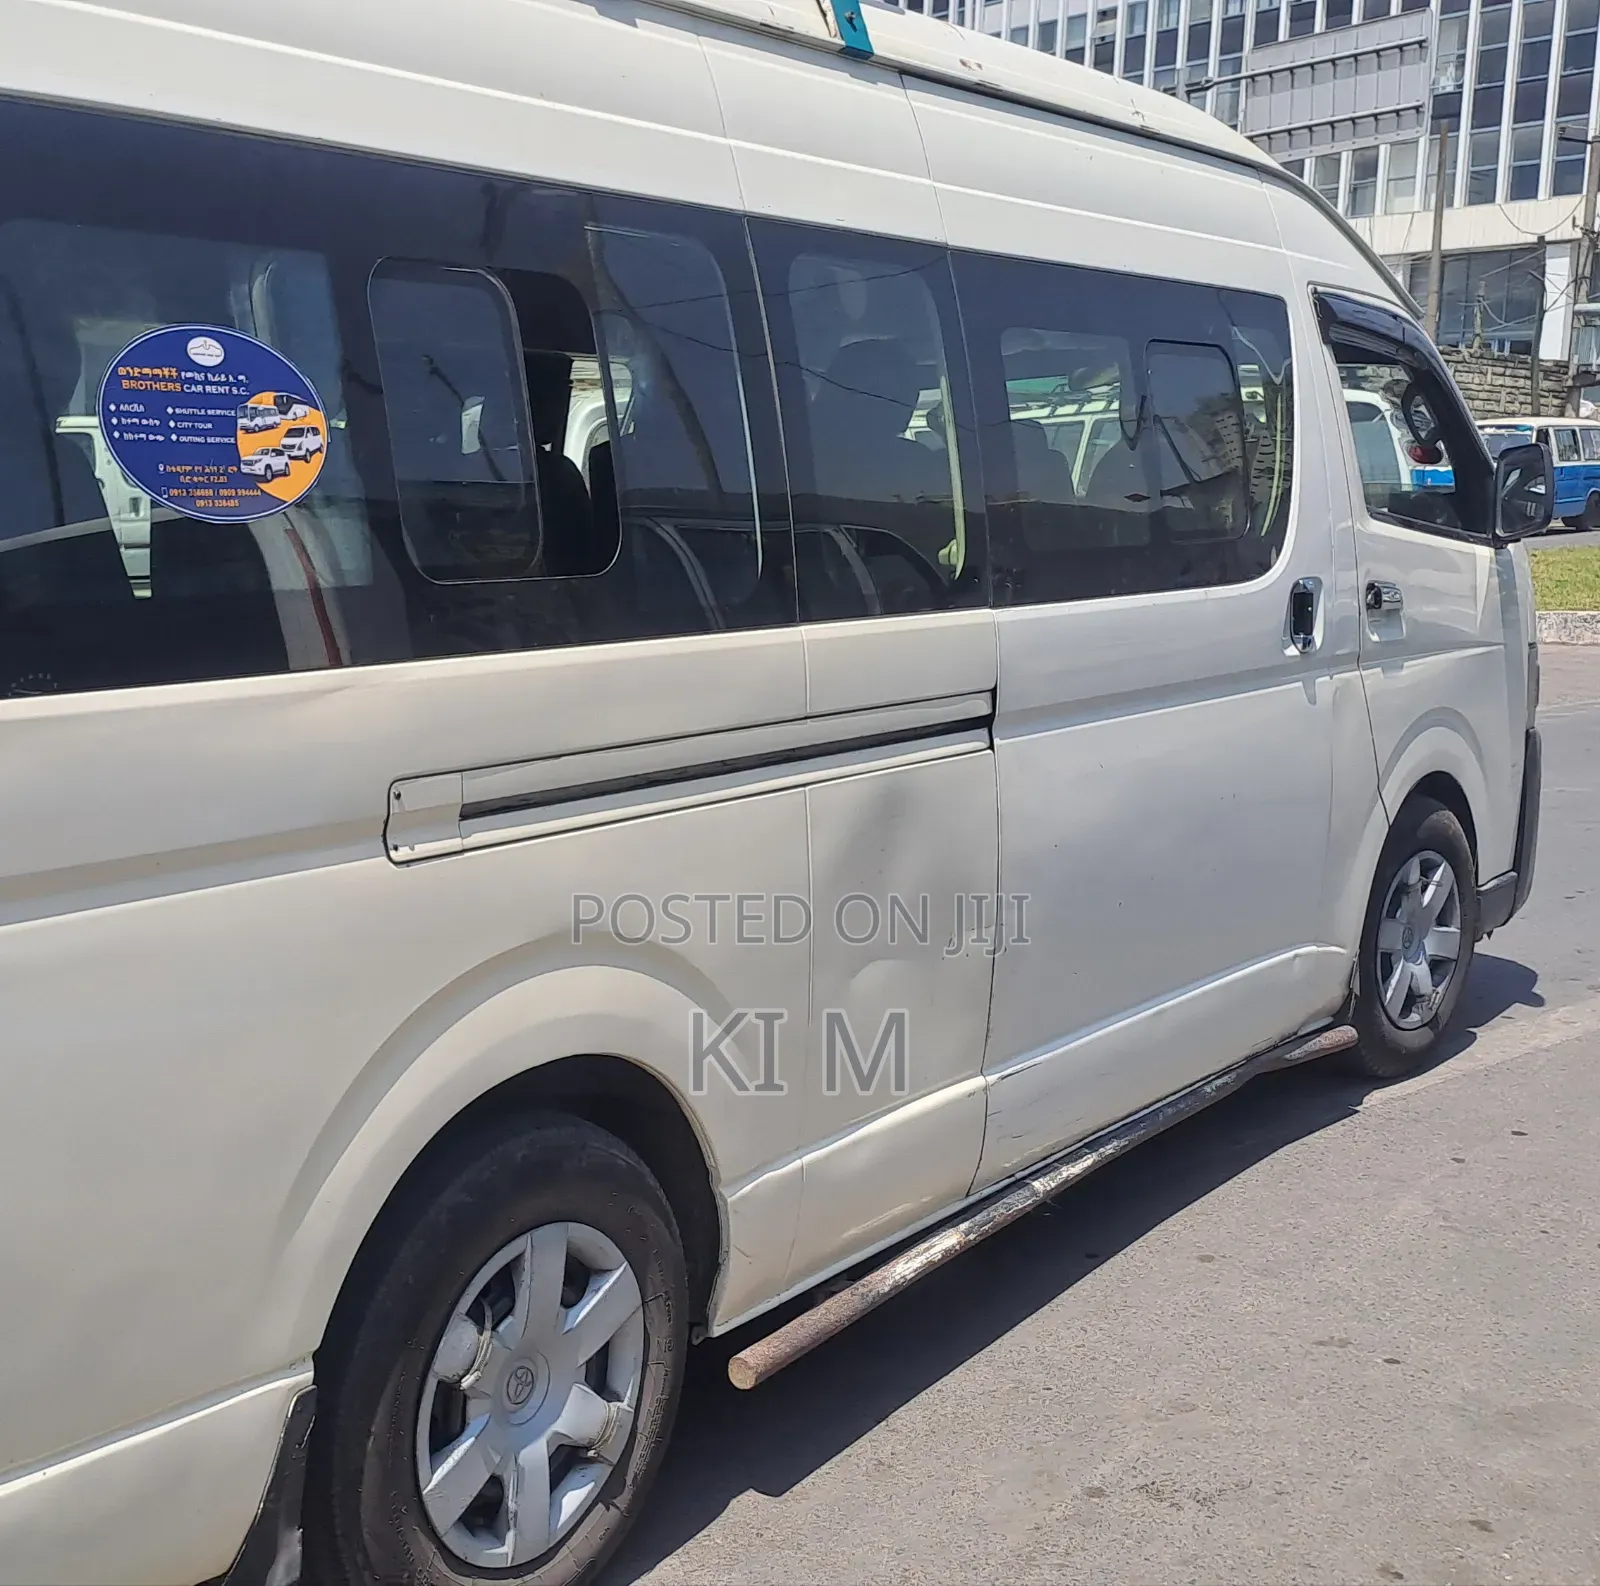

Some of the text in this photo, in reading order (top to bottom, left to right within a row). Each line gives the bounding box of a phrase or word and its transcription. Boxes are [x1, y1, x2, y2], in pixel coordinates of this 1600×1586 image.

[121, 380, 250, 395] BROTHERS CAR RENT S.C.
[175, 407, 206, 415] SHUTTLE
[176, 421, 193, 429] CITY
[179, 435, 236, 444] OUTING SERVICE
